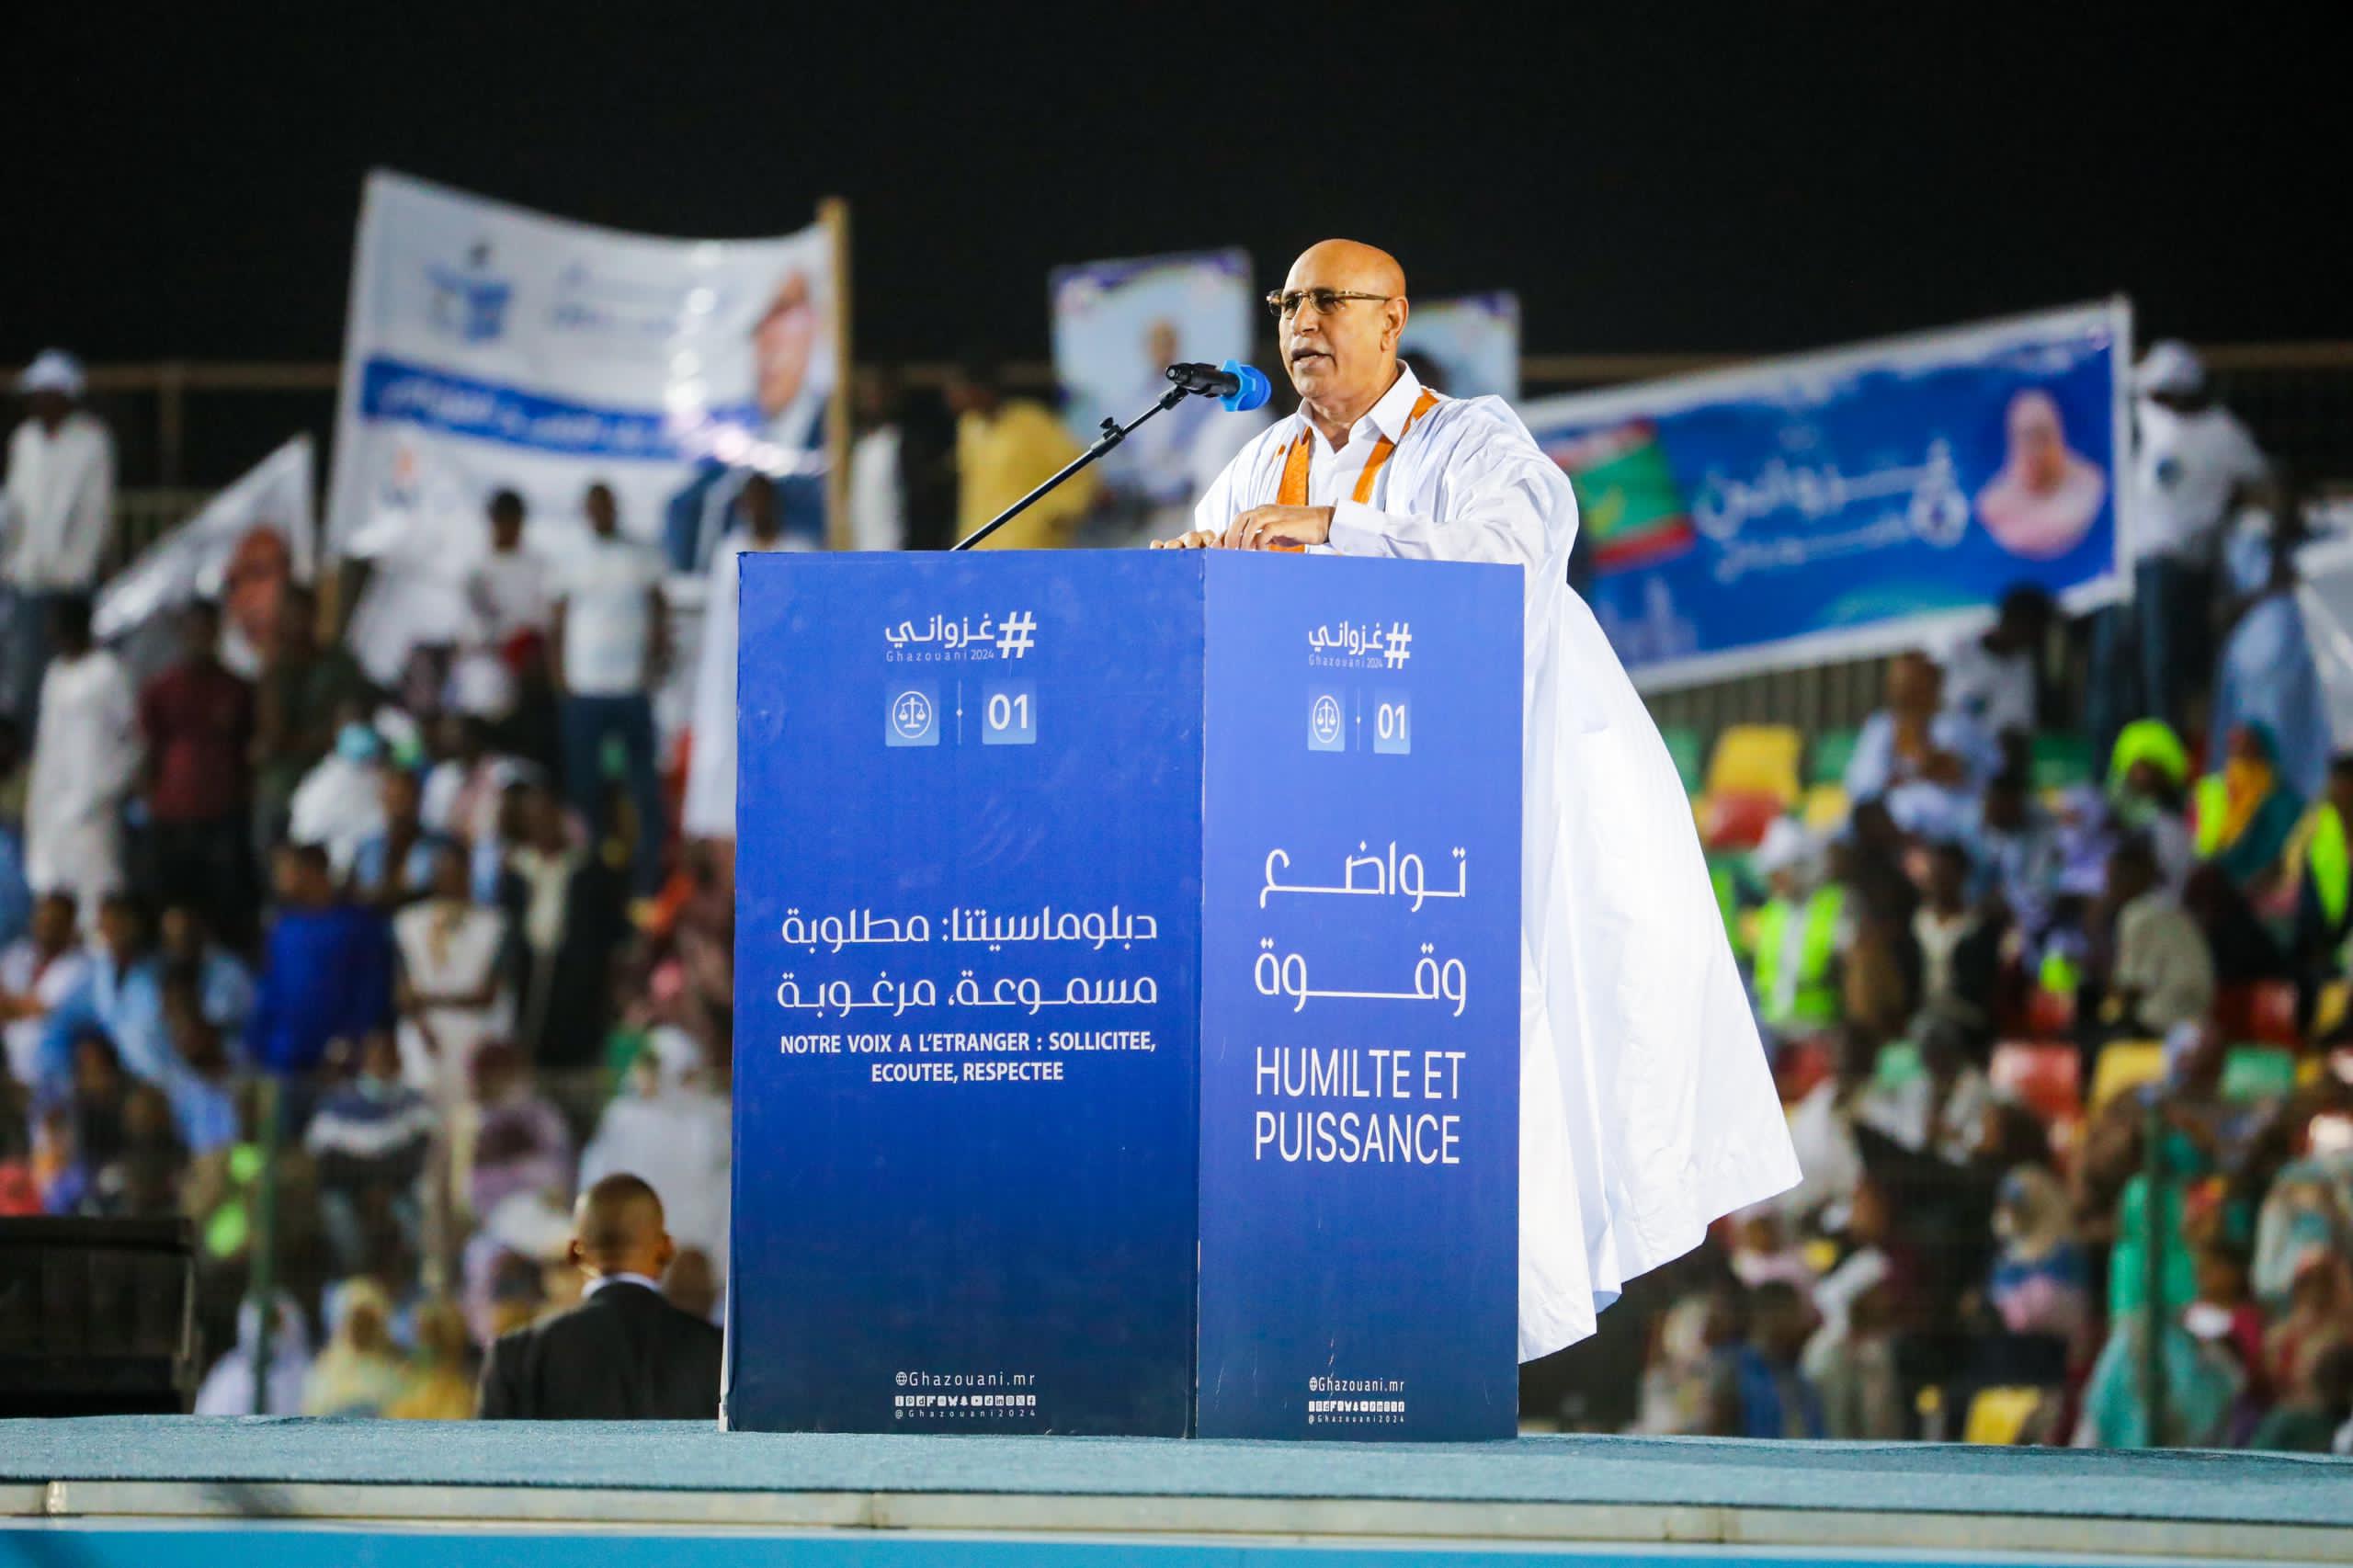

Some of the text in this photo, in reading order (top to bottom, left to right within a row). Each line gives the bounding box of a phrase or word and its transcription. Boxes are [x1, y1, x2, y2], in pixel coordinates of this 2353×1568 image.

[885, 611, 1037, 659] #غزواني
[885, 648, 995, 662] Ghazouani 2024
[1308, 620, 1413, 669] #غزواني
[1308, 653, 1383, 668] Ghazouani 2024
[988, 694, 1028, 731] 01
[1378, 703, 1405, 740] 01
[1259, 840, 1466, 912] تواضع
[781, 904, 1157, 953] دبلوماسيتنا: مطلوبة
[777, 970, 1157, 1017] مسموعة، مرغوبة
[1254, 937, 1467, 1017] وقوة
[780, 1034, 841, 1054] NOTRE
[847, 1034, 892, 1053] VOIX
[899, 1033, 913, 1052] A
[919, 1031, 1030, 1052] L'ETRANGER
[1049, 1030, 1156, 1052] SOLLICITEE,
[871, 1062, 1064, 1084] ECOUTEE, RESPECTEE
[1256, 1046, 1466, 1099] HUMILTE ET
[1256, 1111, 1461, 1165] PUISSANCE
[895, 1409, 1036, 1419] @Ghazouani2024
[1308, 1415, 1404, 1425] @Ghazouani2024
